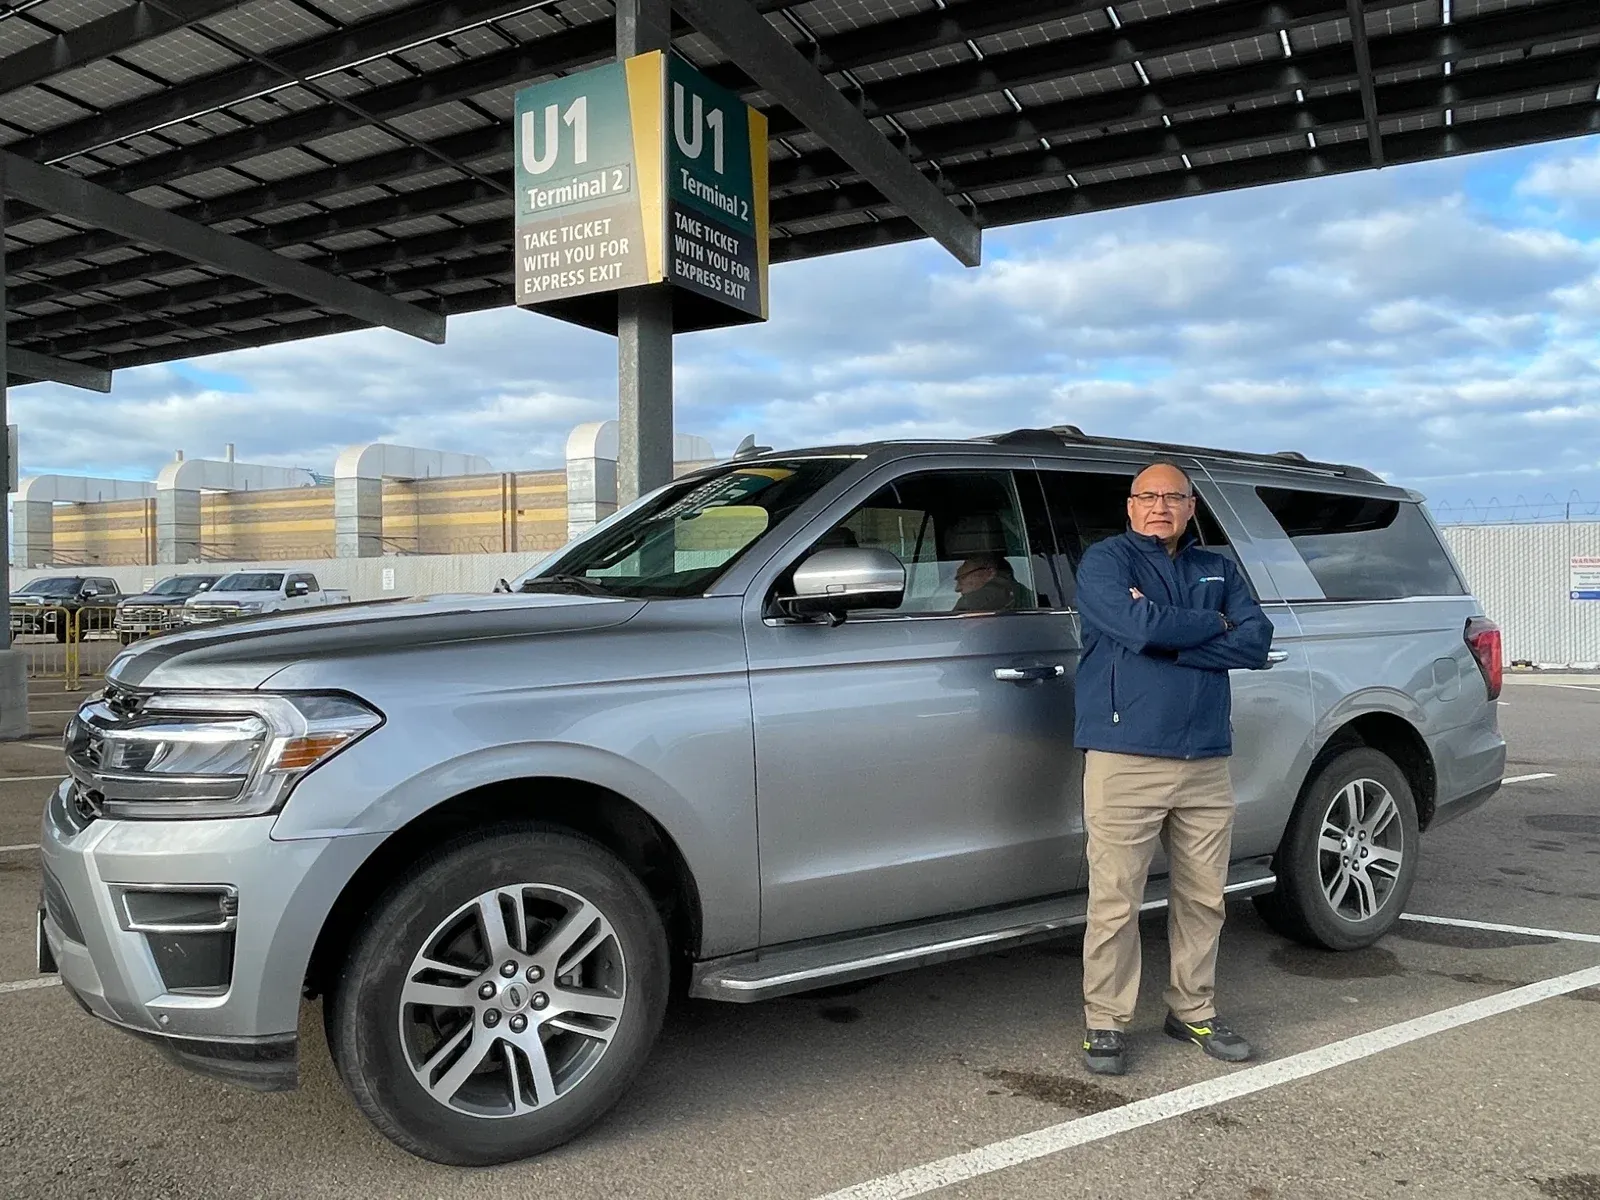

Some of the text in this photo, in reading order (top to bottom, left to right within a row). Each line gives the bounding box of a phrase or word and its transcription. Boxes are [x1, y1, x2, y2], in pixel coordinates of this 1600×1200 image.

[522, 95, 588, 175] U1
[673, 81, 724, 175] U1
[527, 169, 624, 210] Terminal 2
[680, 167, 749, 222] Terminal 2
[523, 218, 612, 251] TAKE TICKET
[523, 237, 629, 272] WITH YOU FOR
[674, 211, 739, 256] TAKE TICKET
[524, 262, 623, 294] EXPRESS EXIT
[674, 234, 751, 282] WITH YOU FOR
[675, 258, 746, 301] EXPRESS EXIT
